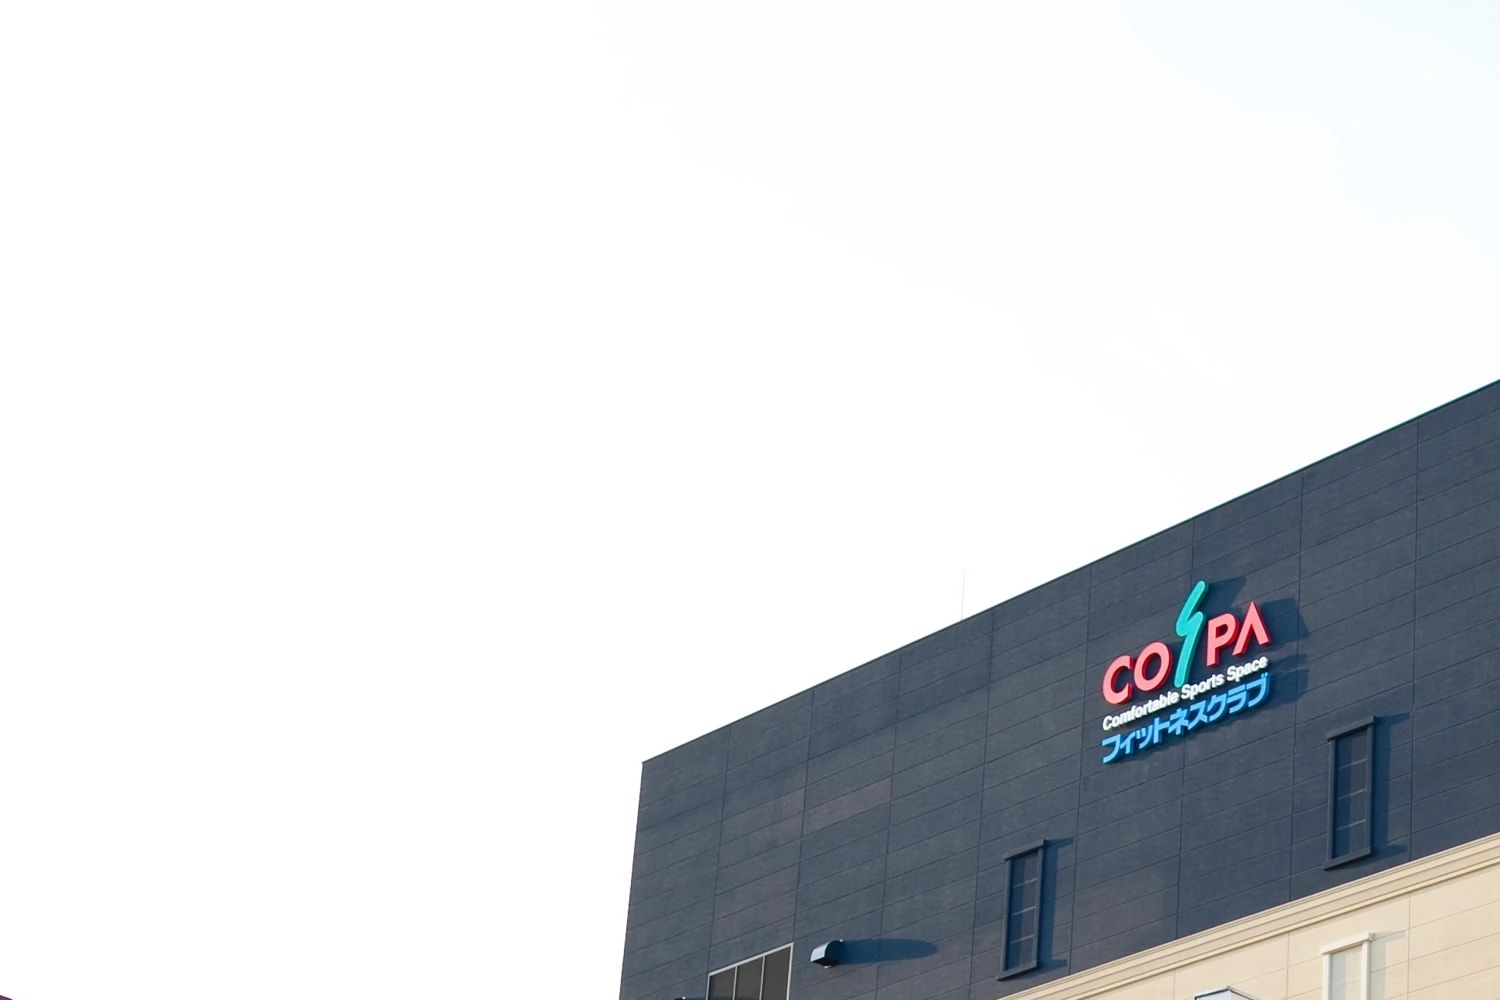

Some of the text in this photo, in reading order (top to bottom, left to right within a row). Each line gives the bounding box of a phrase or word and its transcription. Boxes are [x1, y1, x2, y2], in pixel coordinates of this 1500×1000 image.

[1102, 580, 1273, 705] COSPA
[1101, 671, 1272, 765] フィットネスクラブ
[1102, 655, 1269, 732] Comfortable Sports Space
